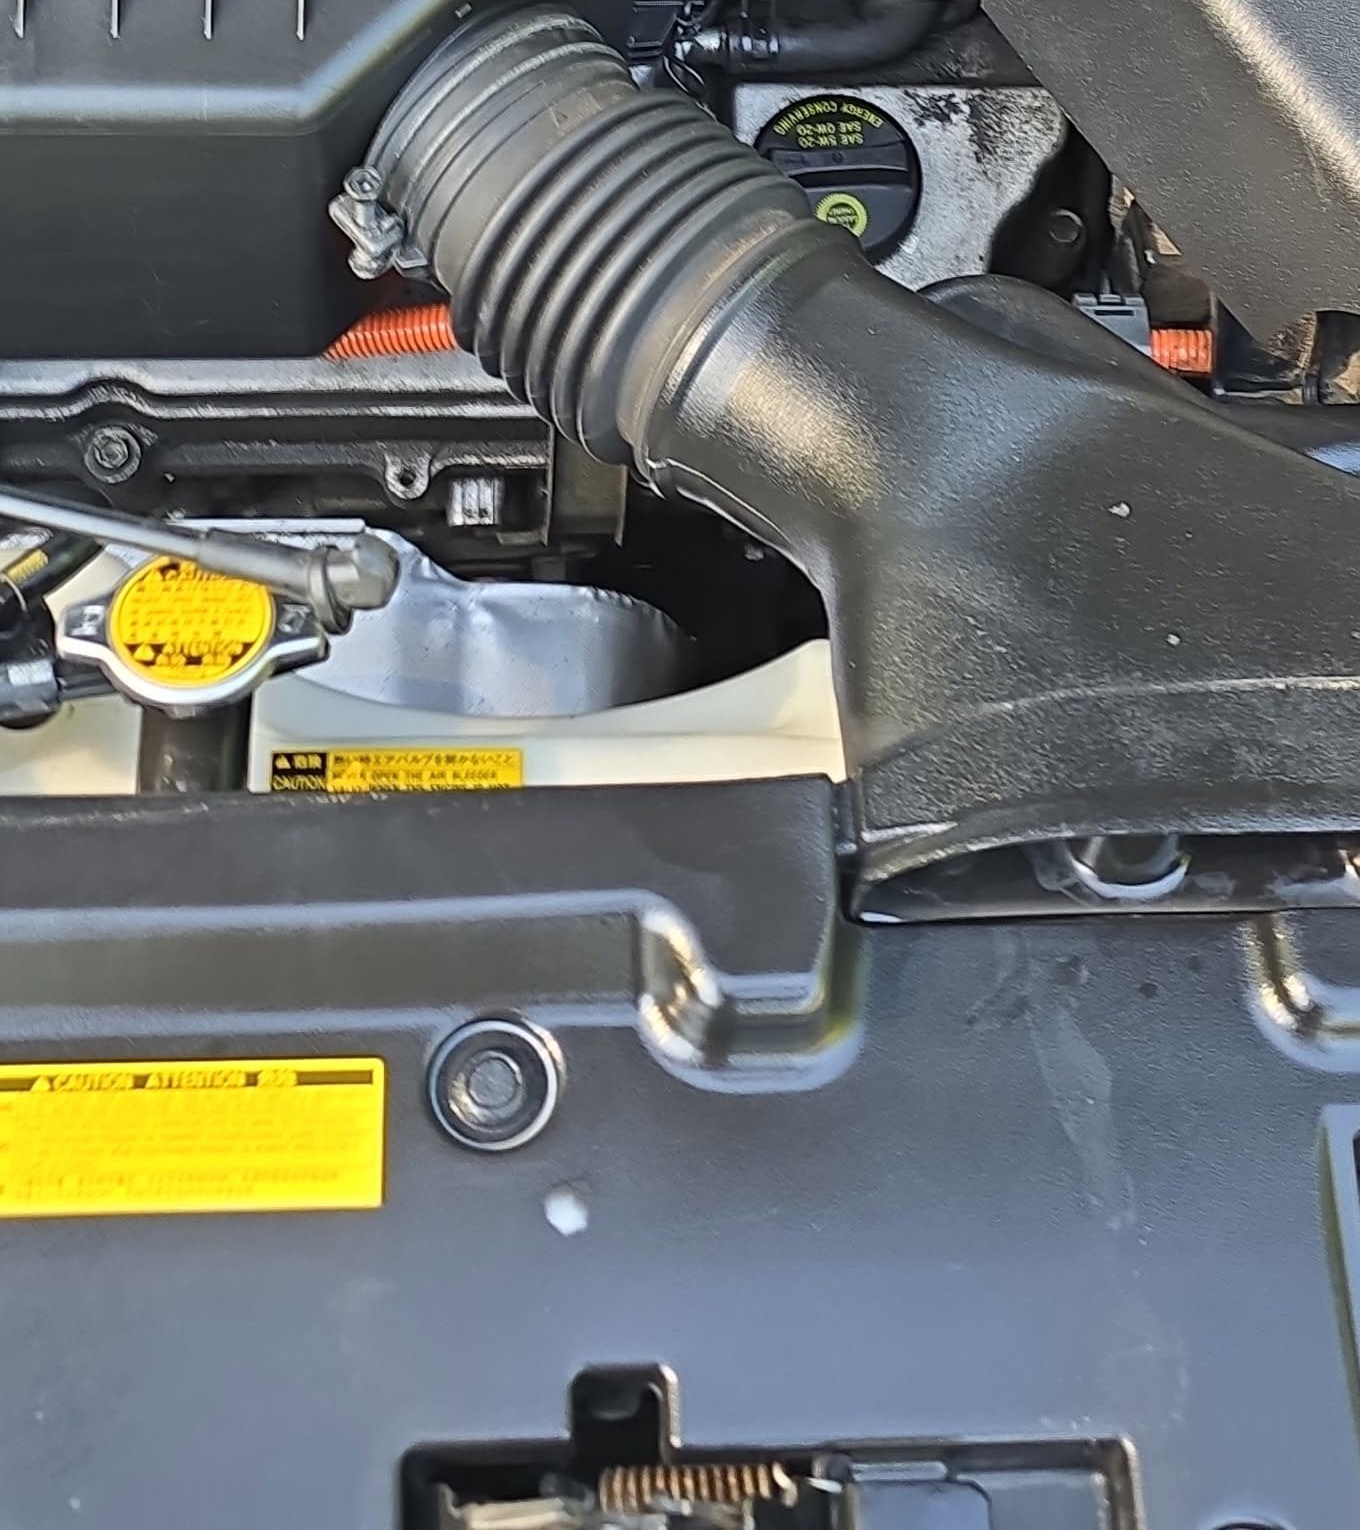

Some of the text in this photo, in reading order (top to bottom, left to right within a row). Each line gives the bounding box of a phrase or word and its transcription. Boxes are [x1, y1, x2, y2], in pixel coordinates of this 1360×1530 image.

[840, 103, 884, 128] ENERGY
[837, 121, 861, 133] SAE
[839, 132, 864, 145] SAE
[272, 774, 326, 791] CAUTION
